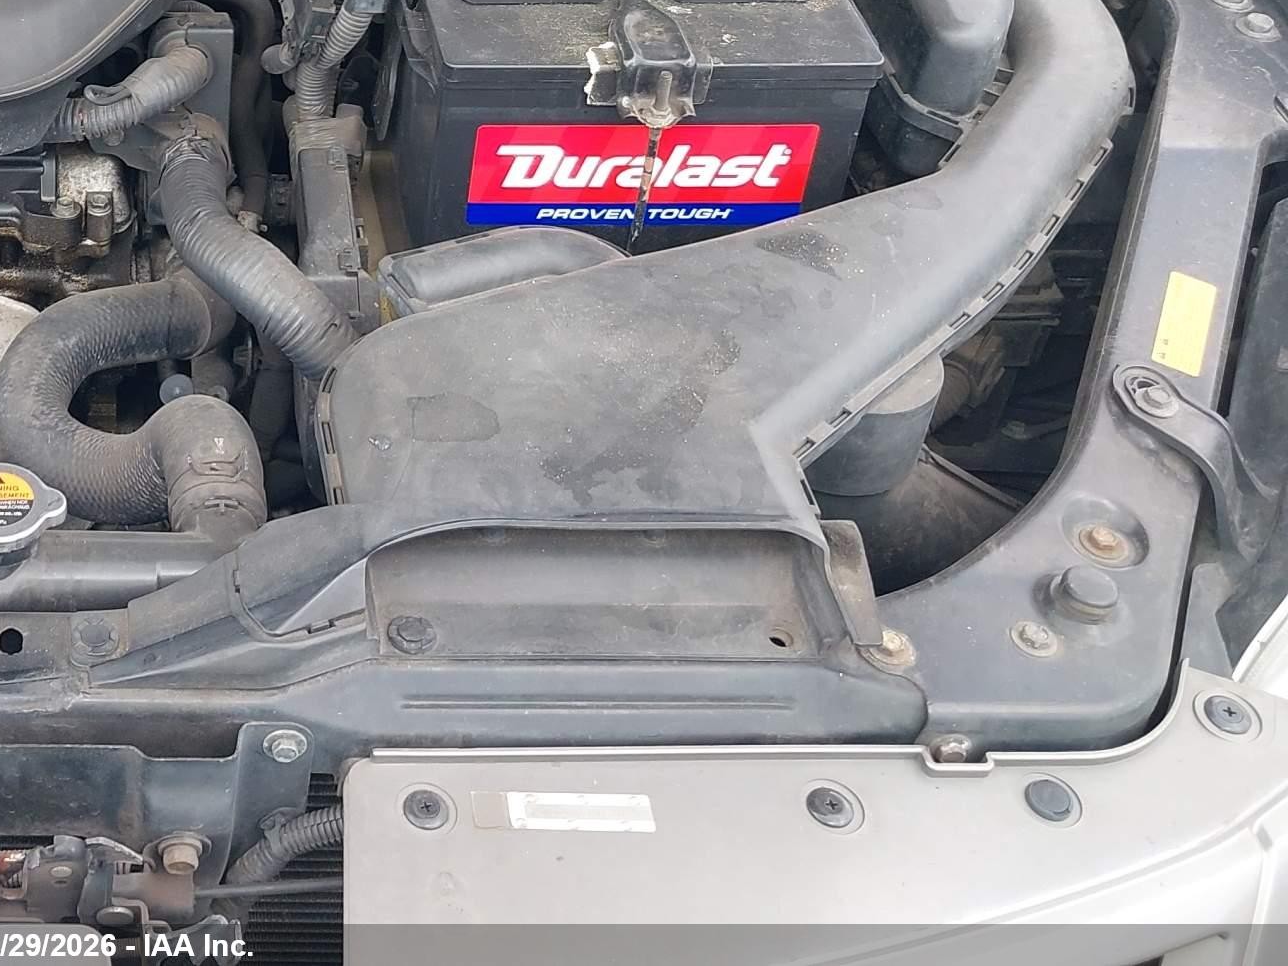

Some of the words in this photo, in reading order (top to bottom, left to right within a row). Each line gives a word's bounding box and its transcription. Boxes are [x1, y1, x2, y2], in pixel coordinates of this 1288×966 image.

[496, 143, 792, 188] Duralast
[536, 208, 636, 221] PROVEN
[646, 208, 732, 221] TOUGH
